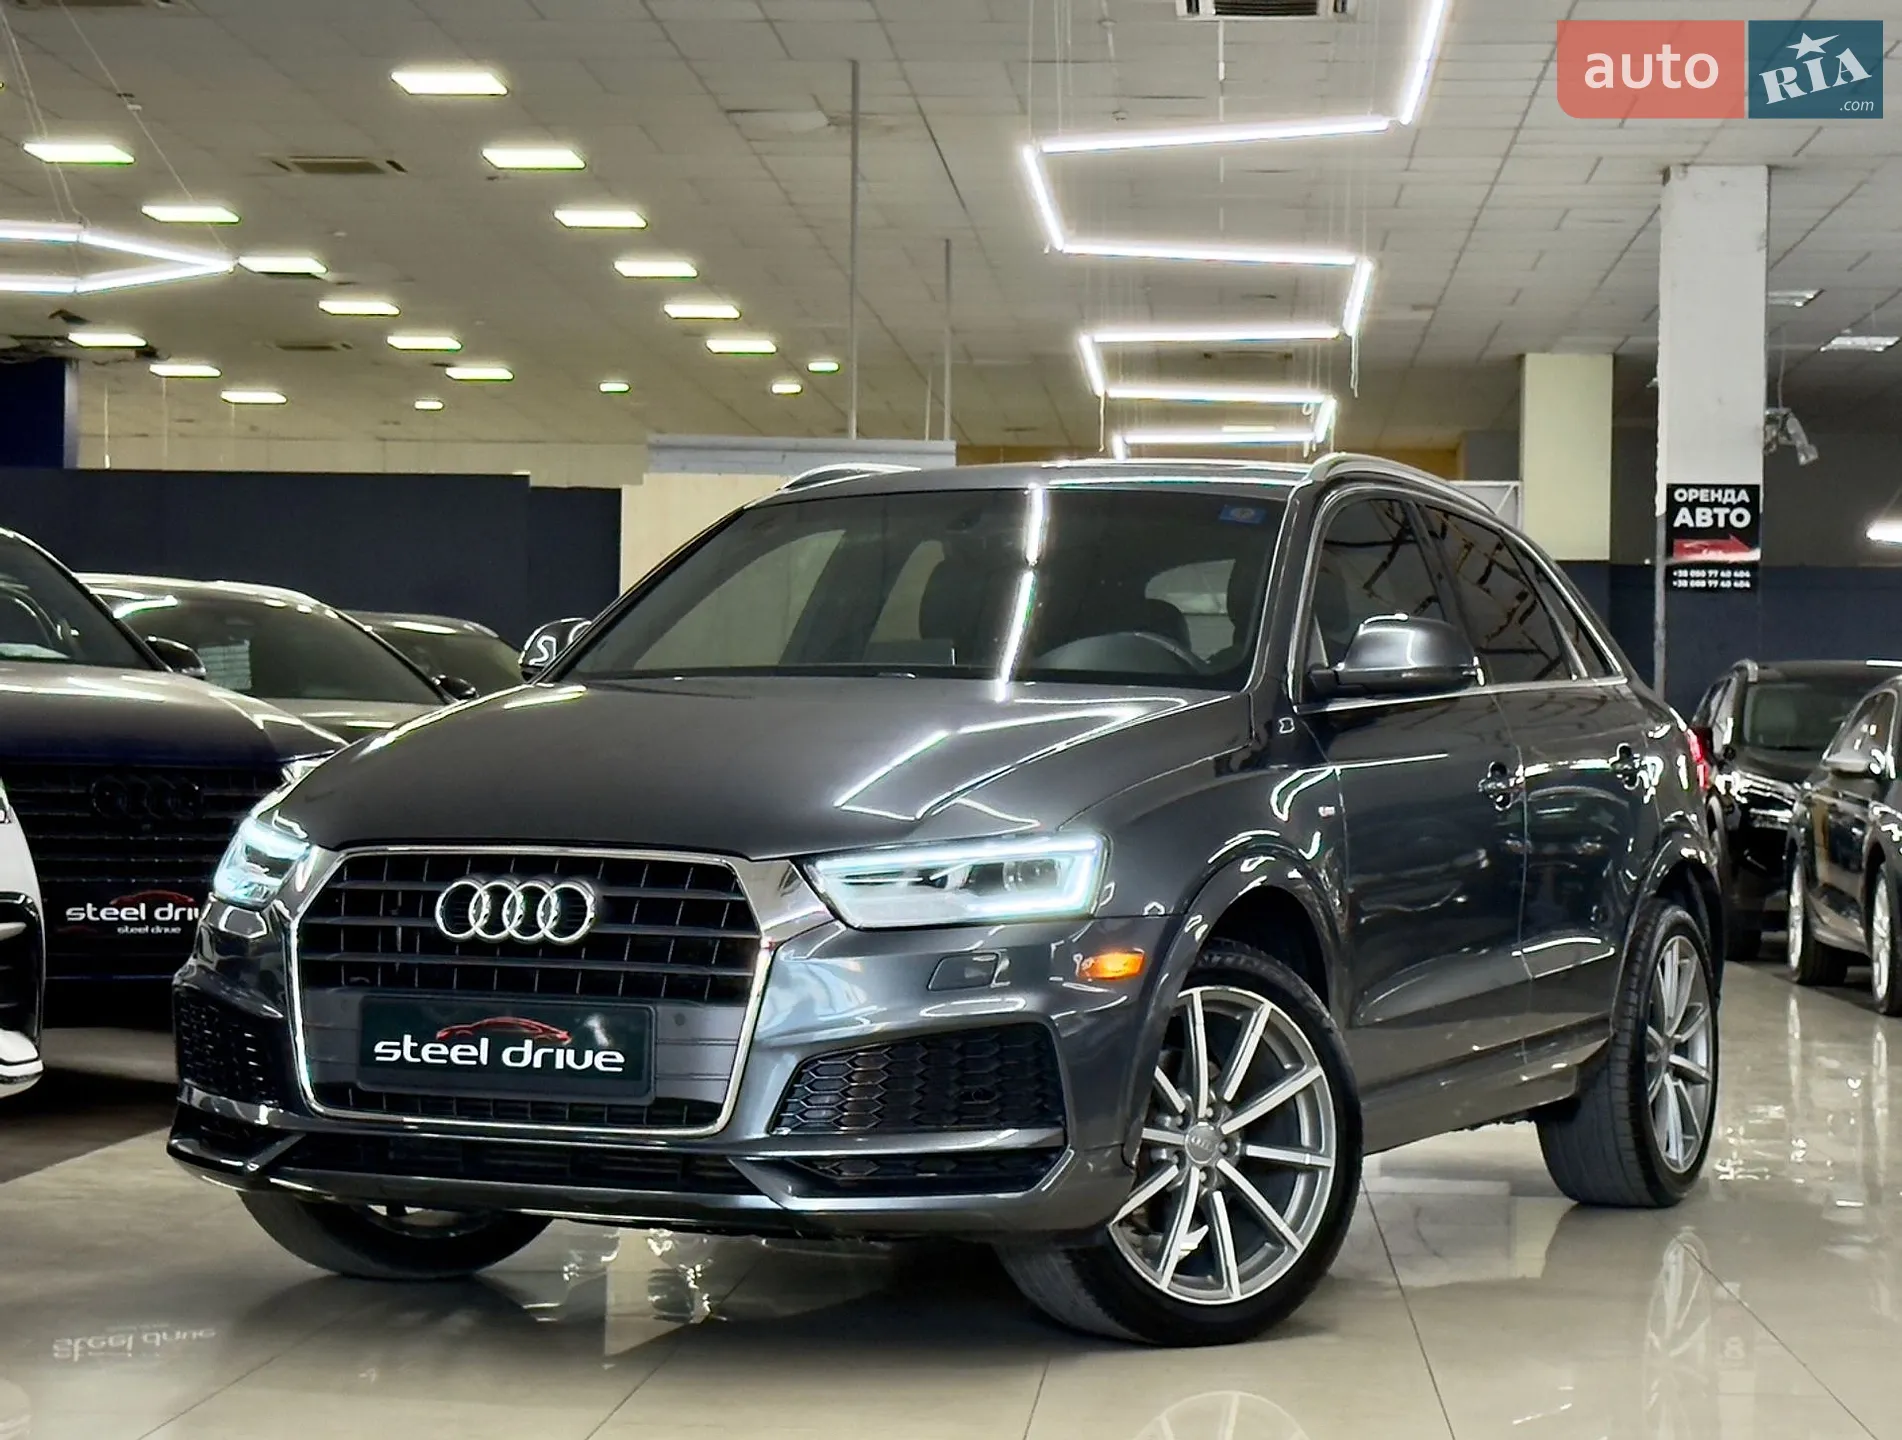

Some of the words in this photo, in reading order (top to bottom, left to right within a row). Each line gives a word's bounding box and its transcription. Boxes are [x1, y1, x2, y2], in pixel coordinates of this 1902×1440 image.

[1673, 487, 1751, 505] ОРЕНДА
[1672, 506, 1752, 529] АВТО
[65, 902, 146, 921] steel
[153, 902, 201, 921] dri
[117, 925, 149, 934] steel
[150, 925, 182, 934] drive
[373, 1034, 490, 1066] steel
[501, 1038, 626, 1073] drive
